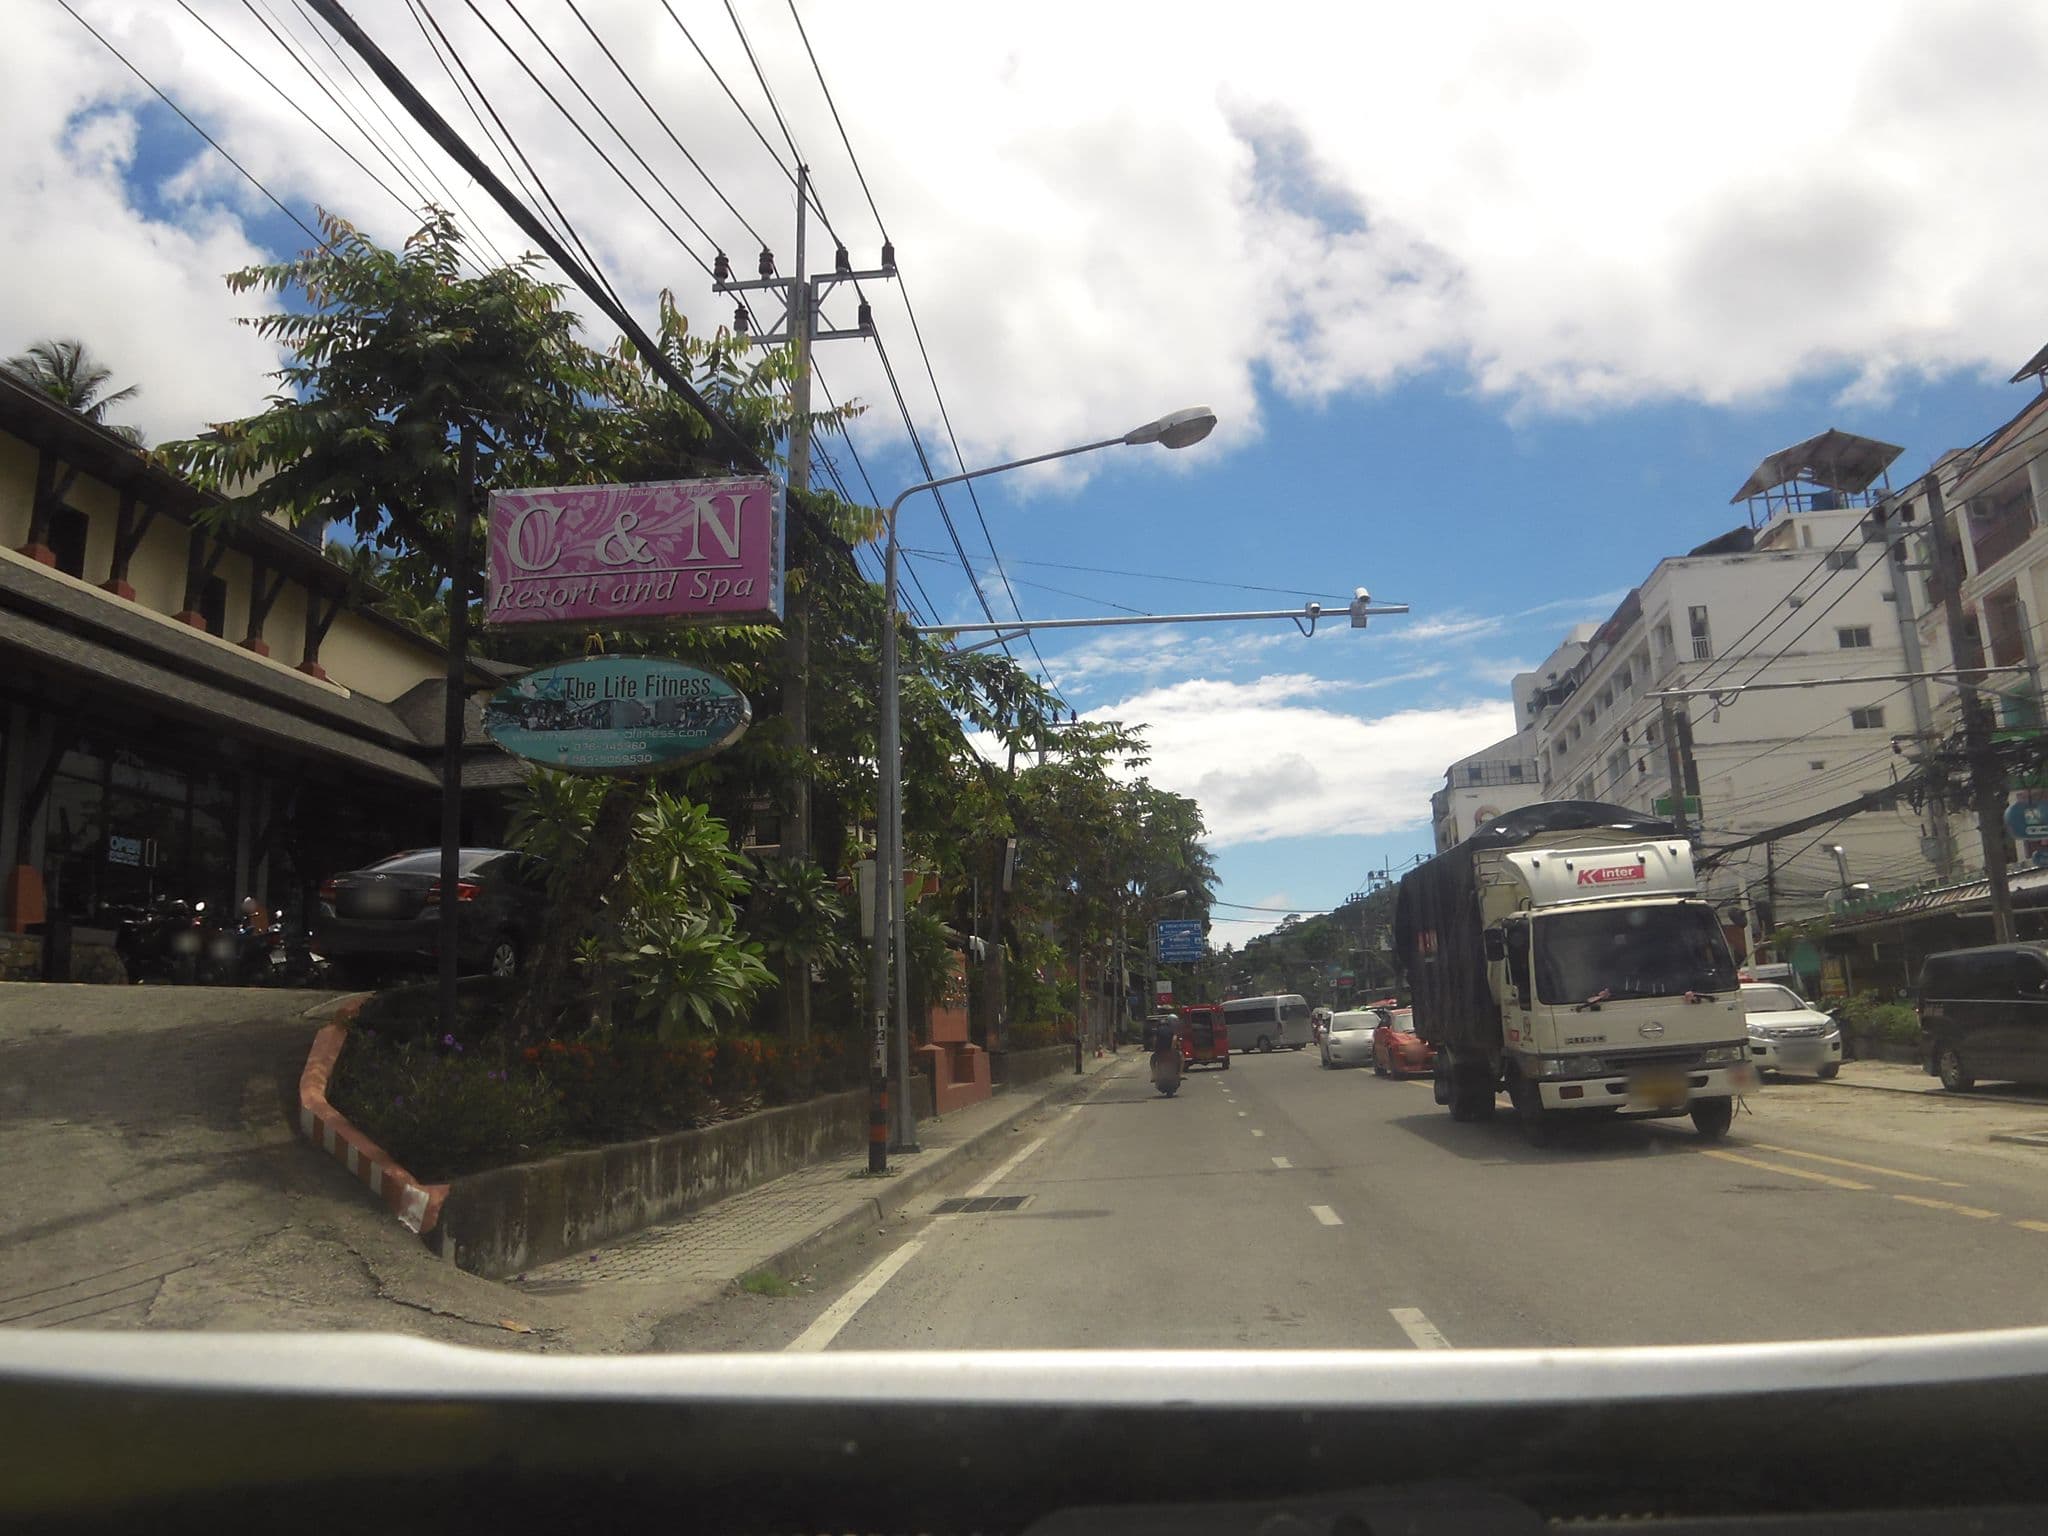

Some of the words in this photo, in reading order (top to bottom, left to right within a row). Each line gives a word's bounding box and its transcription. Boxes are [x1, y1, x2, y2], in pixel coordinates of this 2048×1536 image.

[507, 504, 567, 573] C
[598, 510, 656, 566] &
[684, 495, 751, 561] N
[492, 580, 599, 612] Resort
[611, 571, 678, 604] and
[688, 570, 755, 606] Spa
[564, 676, 596, 700] The
[604, 675, 637, 699] Life
[645, 674, 711, 697] Fitness
